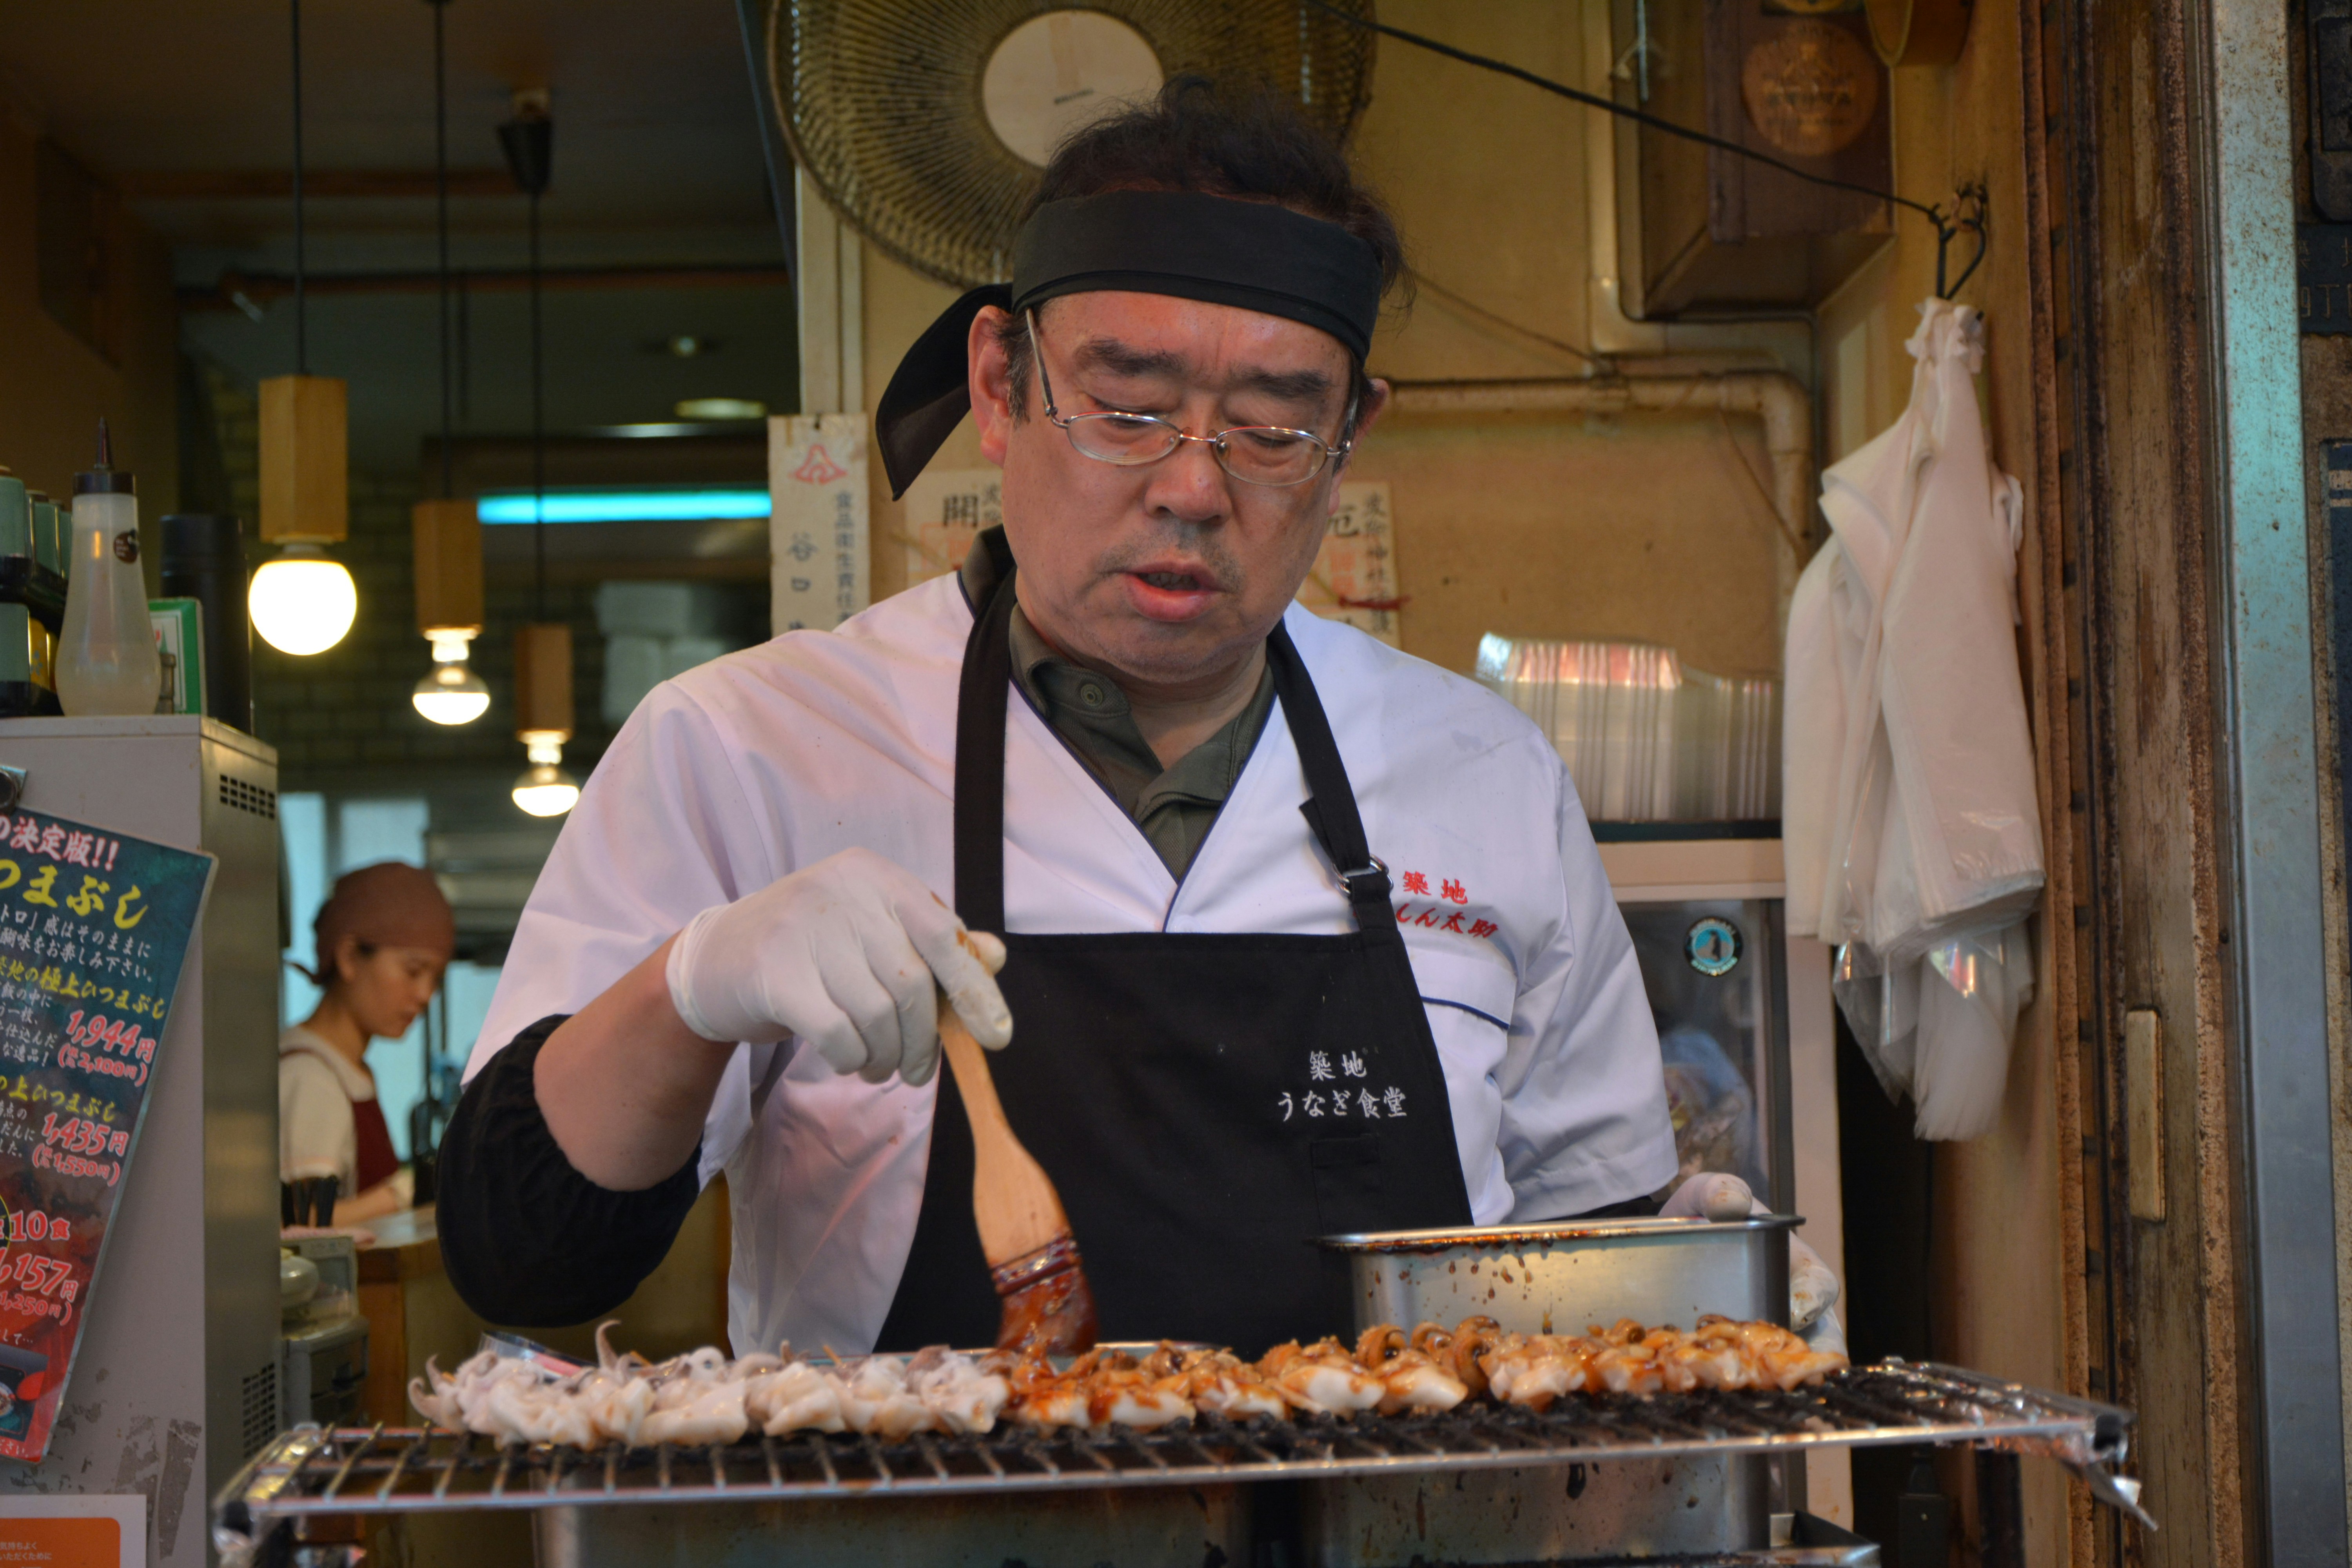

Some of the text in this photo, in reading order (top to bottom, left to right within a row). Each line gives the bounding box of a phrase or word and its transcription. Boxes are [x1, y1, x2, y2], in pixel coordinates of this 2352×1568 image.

[1403, 870, 1468, 905] 築地
[0, 981, 52, 1008] 飯の中に
[0, 1019, 57, 1049] 仕込んだ
[66, 1009, 156, 1063] 1,944円
[1309, 1050, 1367, 1082] 築地
[1278, 1086, 1407, 1122] うなぎ食堂
